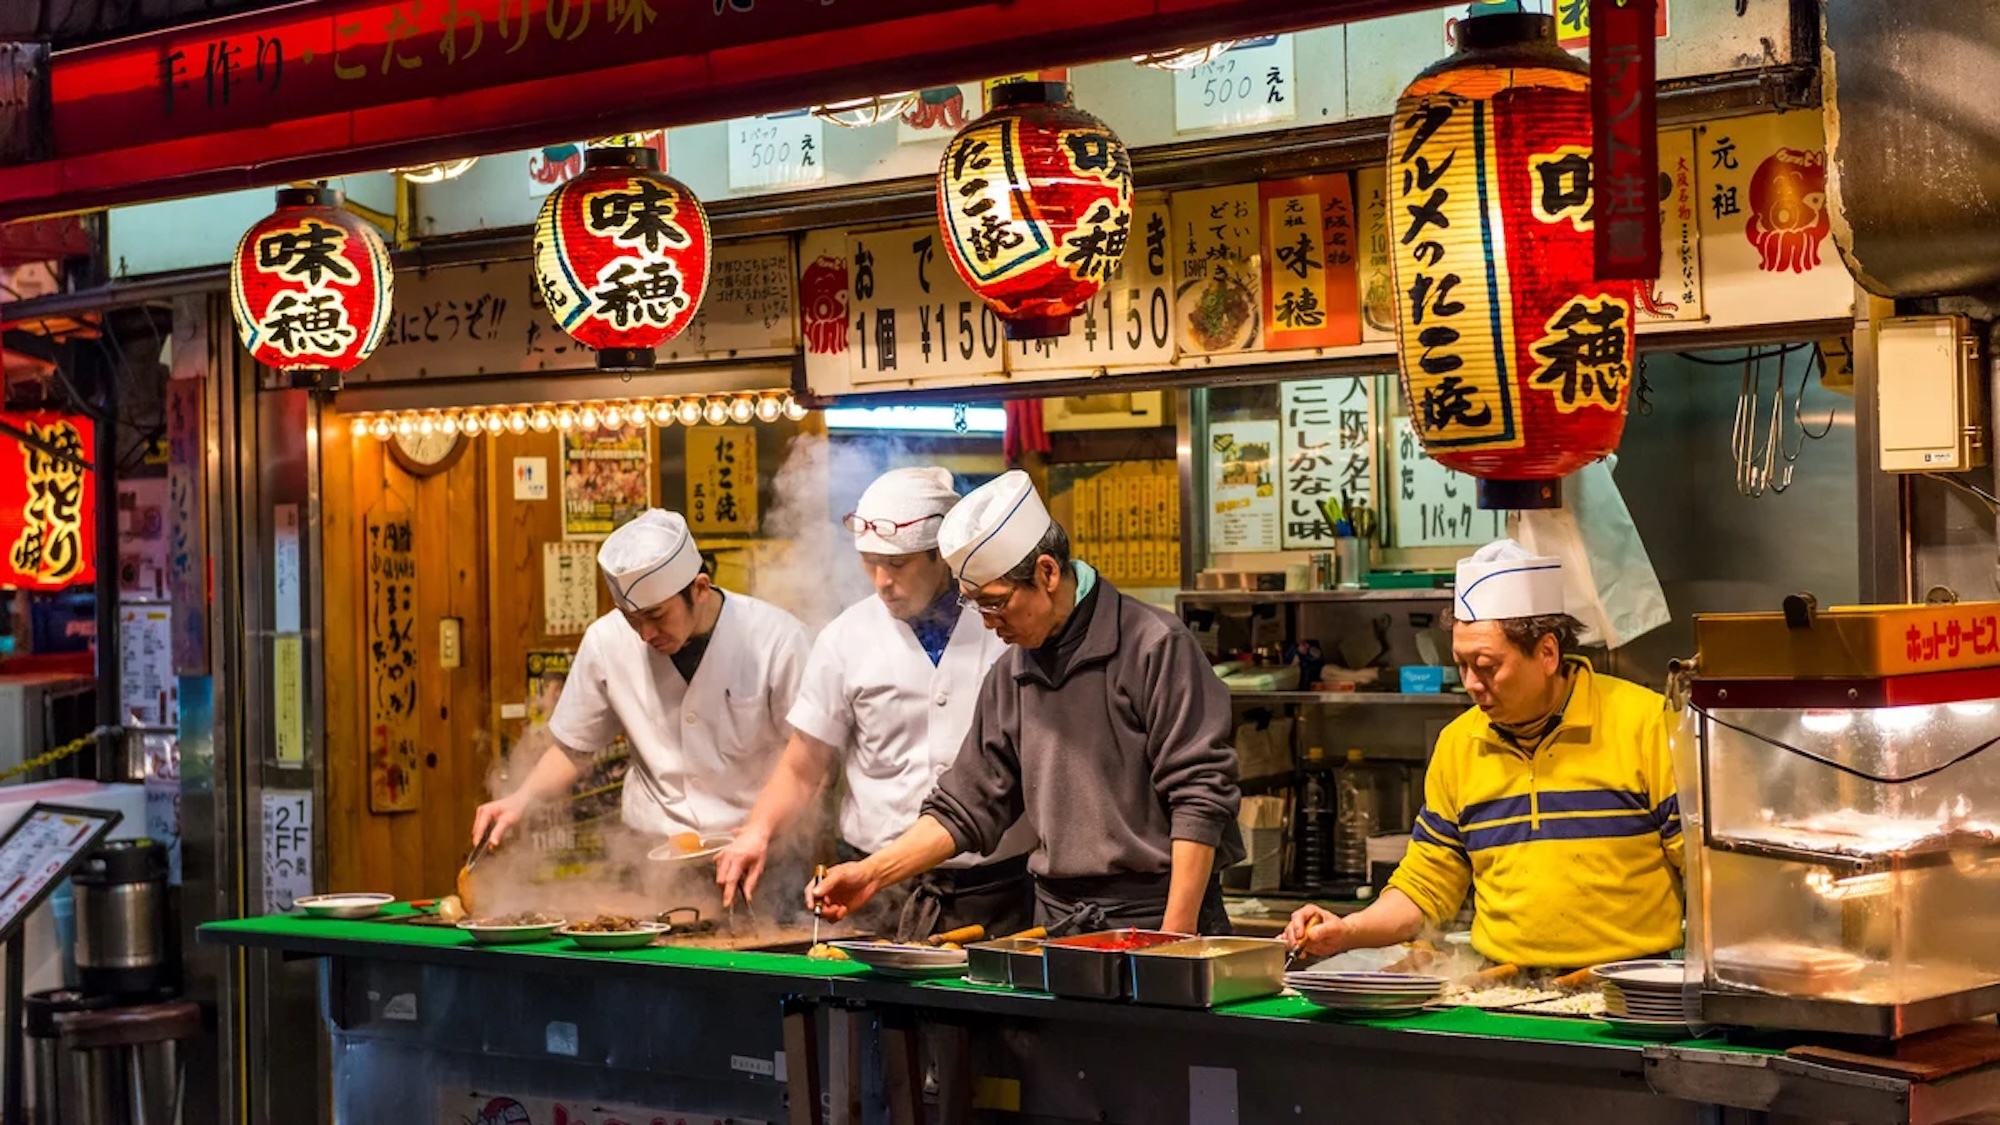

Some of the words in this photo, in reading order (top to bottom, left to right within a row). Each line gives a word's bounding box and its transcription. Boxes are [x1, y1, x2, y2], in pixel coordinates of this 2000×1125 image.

[1204, 76, 1252, 107] 500
[1266, 67, 1284, 103] えん
[752, 142, 790, 169] 500
[801, 134, 815, 167] えん
[1712, 137, 1741, 220] 元祖
[952, 138, 1024, 262] たこ焼
[1064, 133, 1130, 282] 味穂
[1284, 199, 1306, 228] 元祖
[1325, 197, 1352, 265] 大阪名物
[590, 180, 686, 327] 味穂
[1206, 201, 1229, 282] どて焼き
[1274, 233, 1326, 328] 味穂
[1400, 92, 1492, 432] グルメのたこ焼
[259, 222, 353, 352] 味穂
[855, 307, 898, 372] 1個
[919, 301, 998, 363] ¥150
[714, 436, 738, 523] たこ焼
[1905, 615, 2000, 663] ホットサービス
